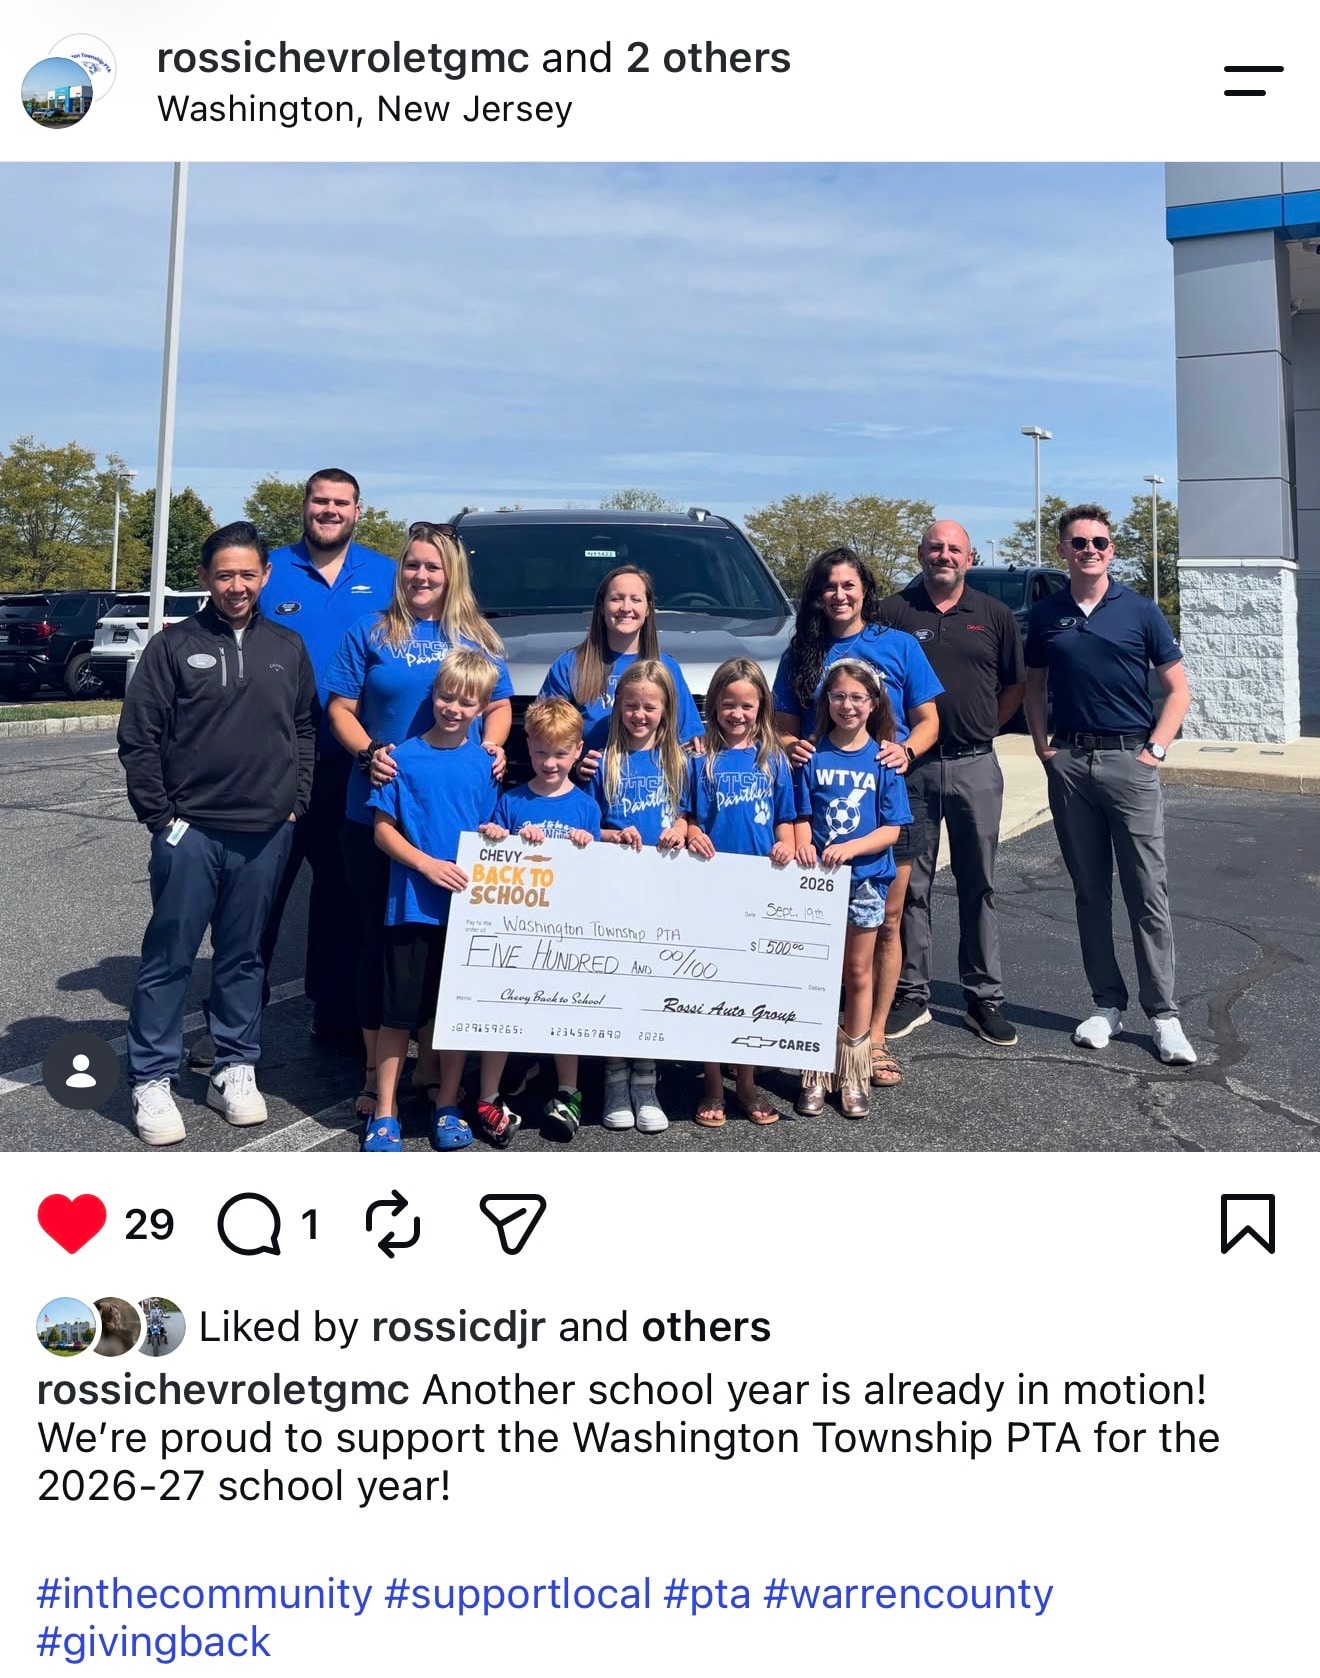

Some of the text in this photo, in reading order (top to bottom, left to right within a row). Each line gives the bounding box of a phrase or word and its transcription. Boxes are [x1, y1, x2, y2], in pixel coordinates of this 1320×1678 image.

[816, 768, 876, 791] WTYA
[479, 849, 522, 863] CHEVY
[472, 863, 554, 888] BACK TO
[799, 876, 834, 892] 2026
[469, 885, 551, 908] SCHOOL
[766, 902, 824, 921] Sept. 19th
[465, 919, 476, 927] Pay
[503, 916, 681, 943] Washington Township PTA
[467, 935, 523, 968] FIVE
[532, 938, 619, 974] HUNDRED
[750, 940, 757, 951] $
[500, 988, 606, 1006] Chevy Back to School
[808, 984, 826, 993] Dollars
[662, 997, 798, 1024] Rossi Auto Group
[550, 1026, 621, 1040] 1234567890
[638, 1031, 665, 1043] 2026
[778, 1038, 821, 1053] CARES
